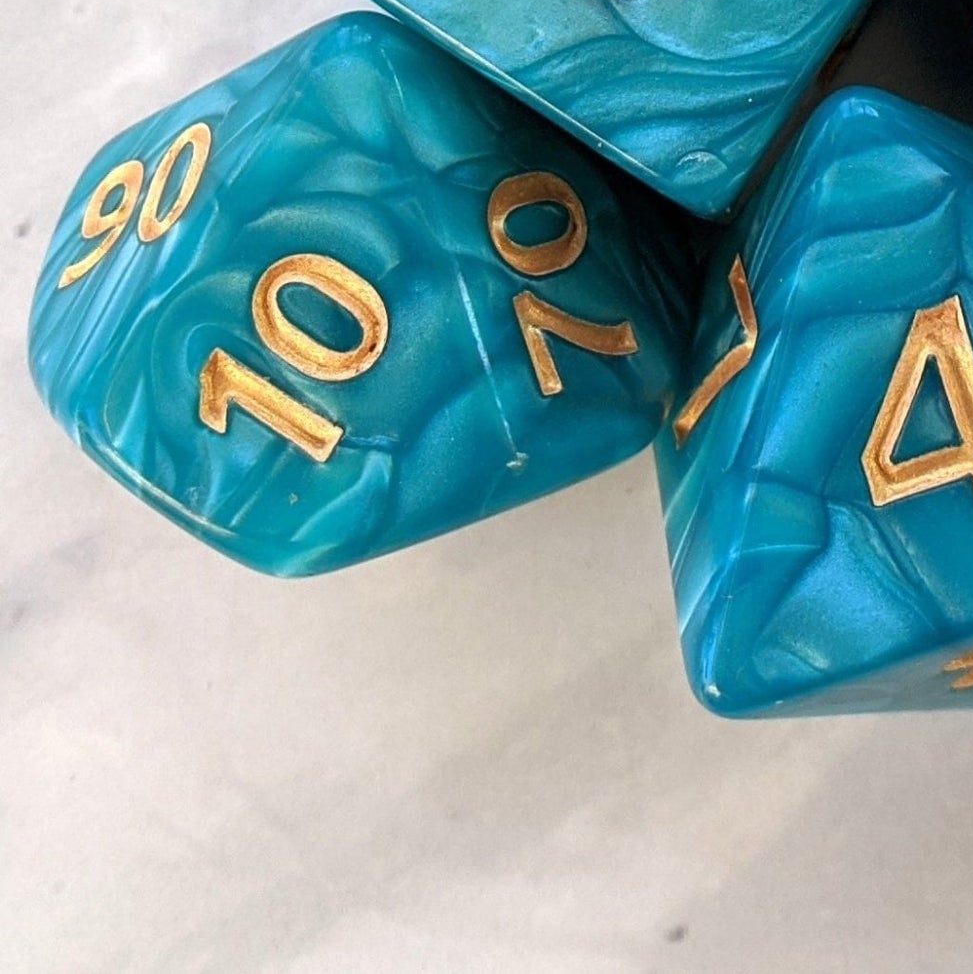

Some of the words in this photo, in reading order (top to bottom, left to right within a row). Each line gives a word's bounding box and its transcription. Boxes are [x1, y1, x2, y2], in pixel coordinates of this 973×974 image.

[58, 122, 213, 289] 90
[486, 170, 640, 397] 70
[198, 252, 390, 463] 10
